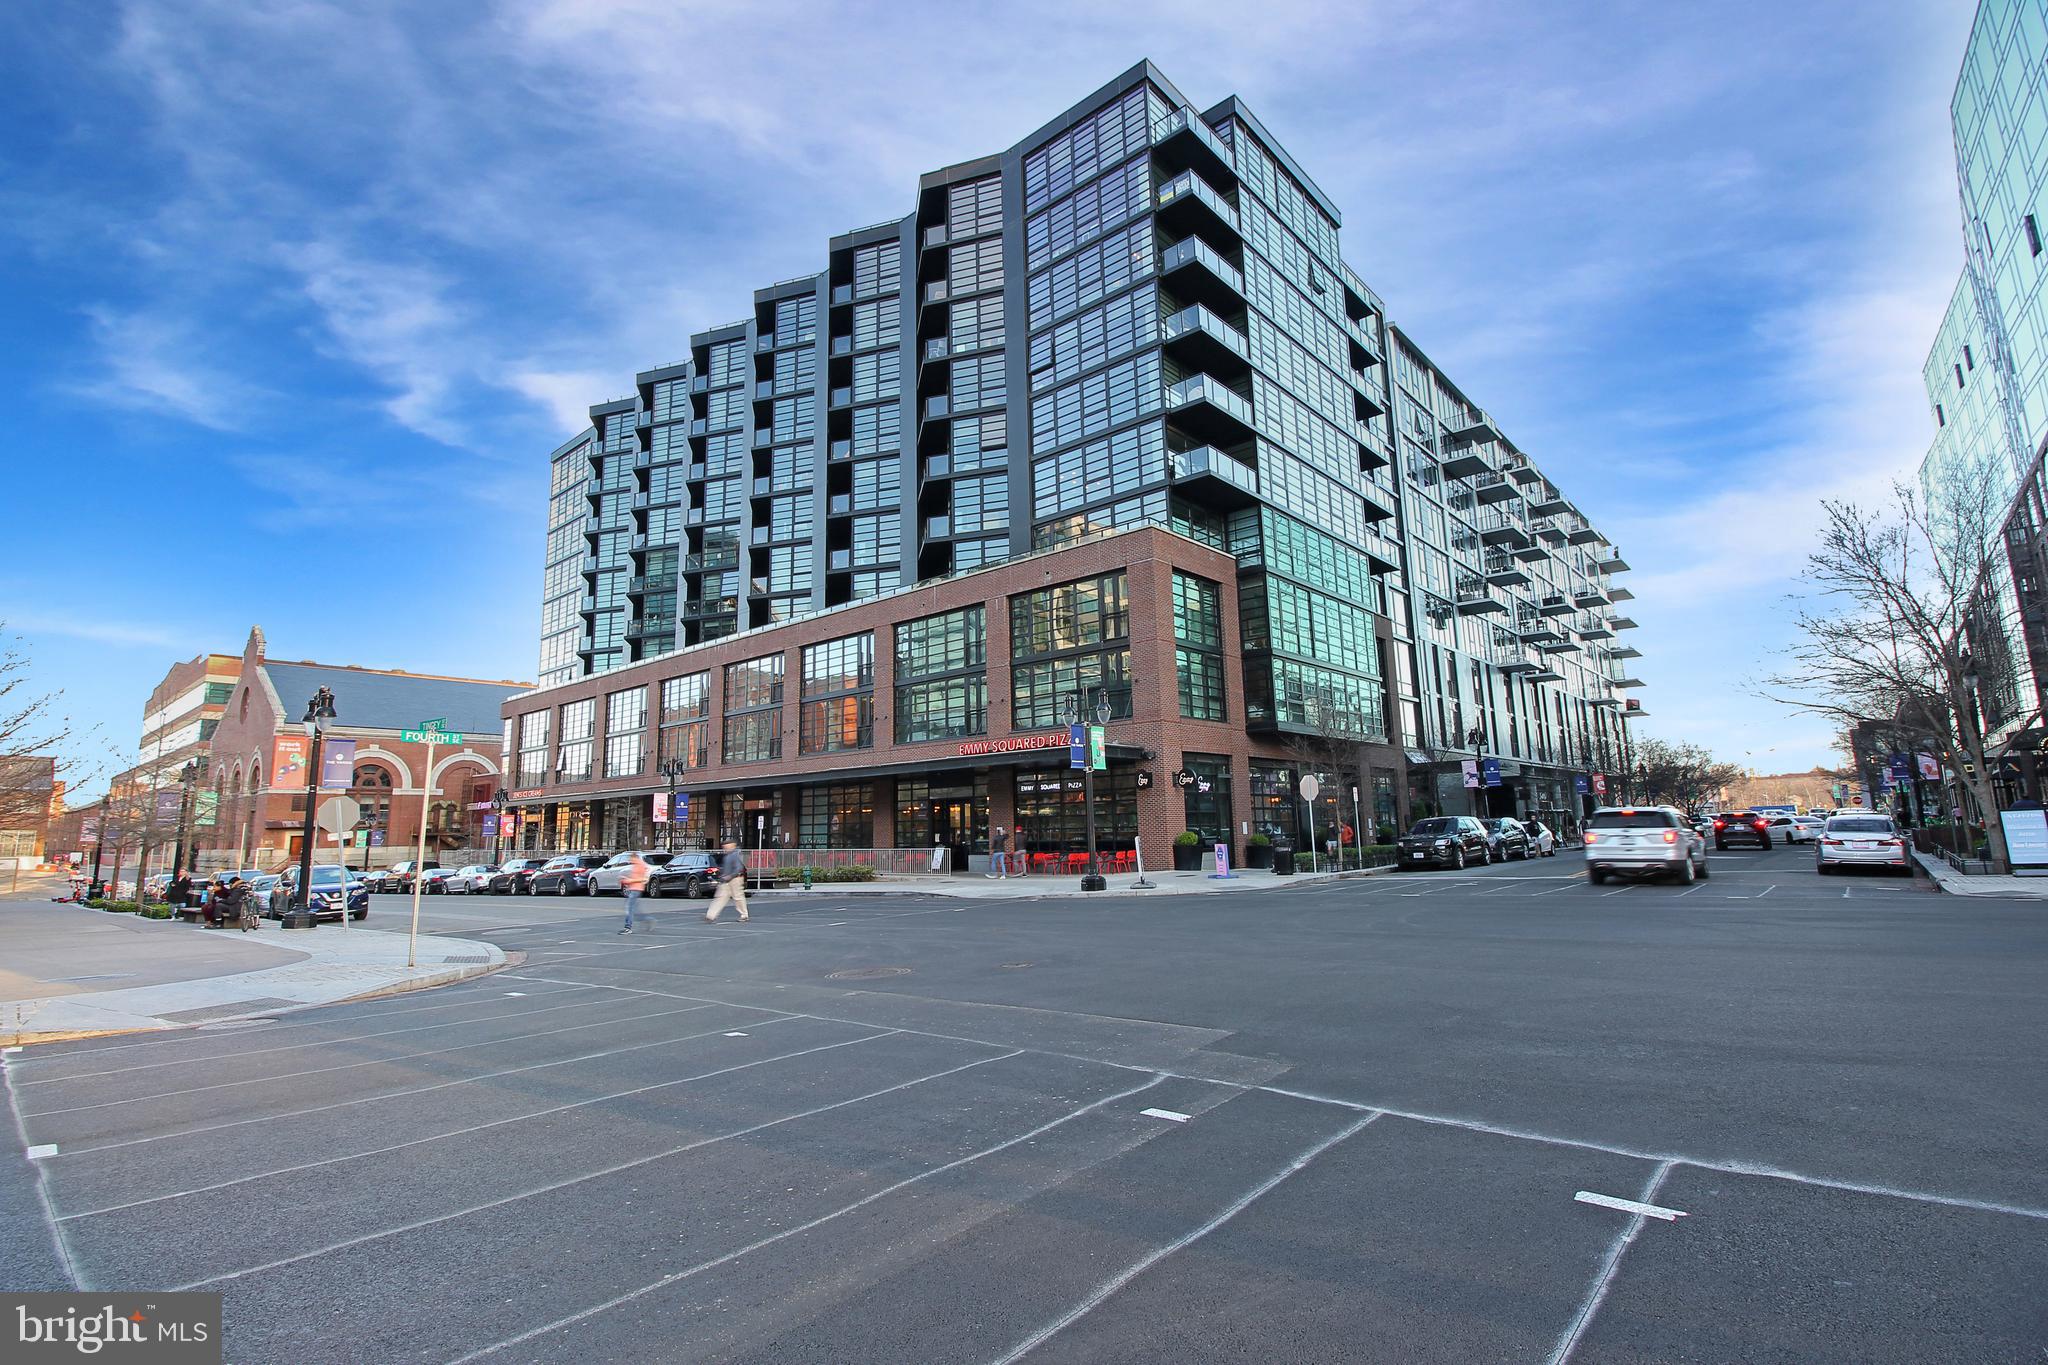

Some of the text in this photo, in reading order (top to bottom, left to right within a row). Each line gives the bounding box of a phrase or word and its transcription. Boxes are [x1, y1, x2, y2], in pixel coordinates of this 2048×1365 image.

[405, 731, 449, 743] FOURTH
[959, 742, 989, 755] EMMY
[992, 736, 1046, 752] SQUARED
